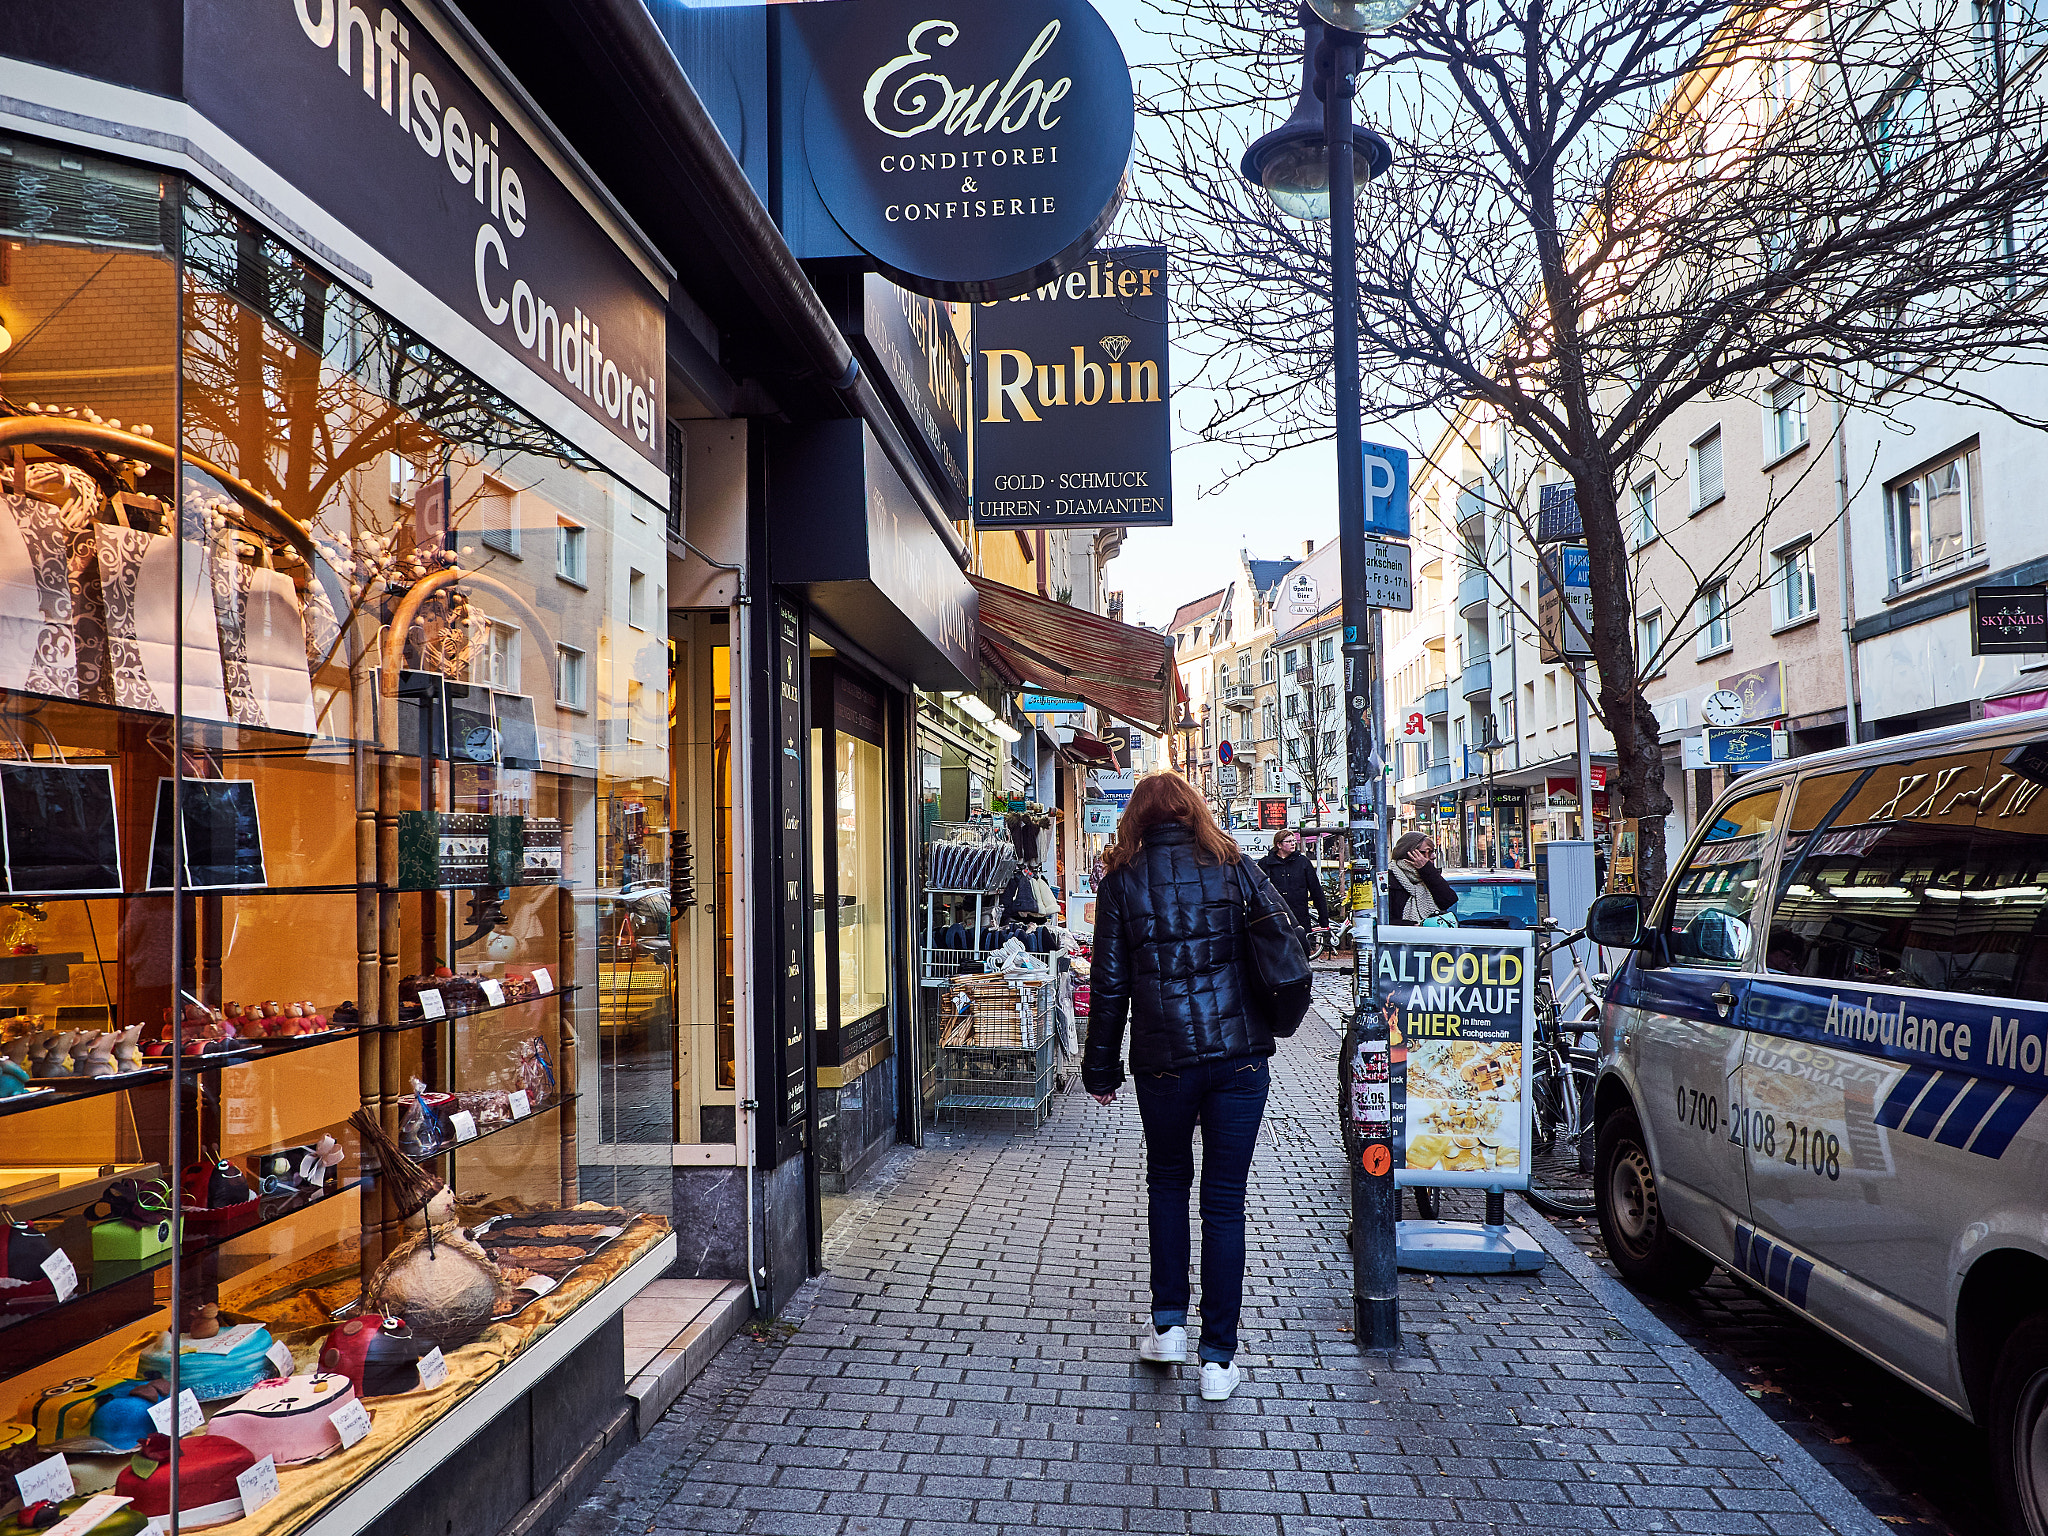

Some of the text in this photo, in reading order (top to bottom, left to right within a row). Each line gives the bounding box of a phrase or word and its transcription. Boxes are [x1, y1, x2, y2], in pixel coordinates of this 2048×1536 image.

[295, 0, 526, 237] onfiserie
[880, 147, 1058, 173] CONDITOREI
[961, 176, 978, 193] &
[885, 197, 1057, 222] CONFISERIE
[980, 262, 1158, 308] uwelier
[474, 223, 655, 450] Conditorei
[928, 298, 962, 433] Rubin
[980, 346, 1162, 423] Rubin
[994, 471, 1149, 491] GOLD SCHMUCK
[1364, 454, 1395, 522] P
[979, 498, 1164, 518] UHREN DIAMANTEN
[1375, 545, 1388, 557] mit
[1366, 557, 1403, 571] arkschein
[1374, 574, 1381, 584] Fr
[1384, 575, 1389, 585] 9
[1377, 590, 1382, 600] 8
[1565, 592, 1581, 604] Hier
[1981, 614, 2044, 626] SKY NAILS
[781, 682, 799, 702] ROLEX
[1548, 795, 1577, 806] Marlboro
[784, 808, 799, 830] Cartier
[787, 881, 799, 901] IWC
[1378, 950, 1523, 986] ALTGOLD
[1407, 985, 1520, 1015] ANKAUF
[1407, 1013, 1461, 1037] HIER
[1471, 1018, 1491, 1027] Ihrem
[1463, 1029, 1510, 1039] Fachgeschäft
[1824, 994, 1971, 1060] Ambulance
[1986, 1016, 2048, 1075] Mo
[1785, 1120, 1840, 1182] 2108
